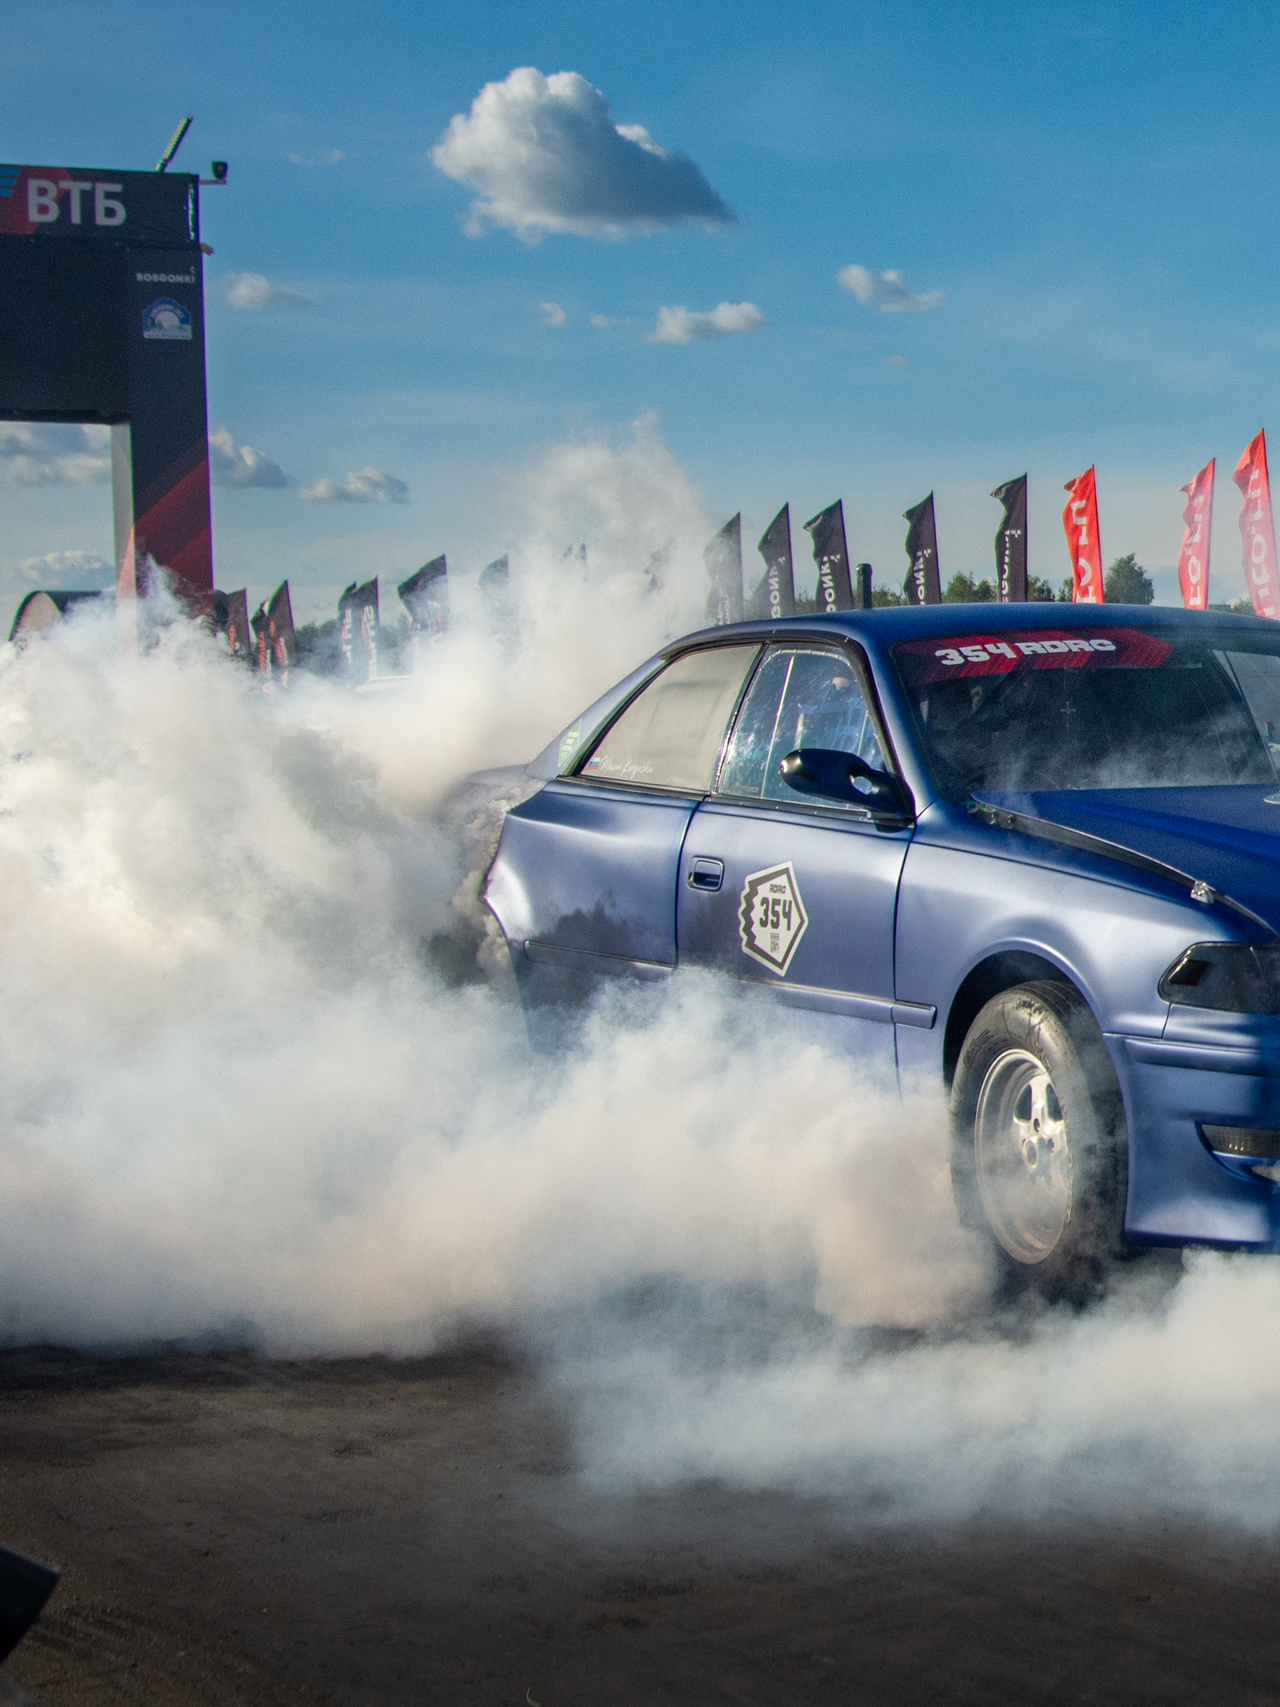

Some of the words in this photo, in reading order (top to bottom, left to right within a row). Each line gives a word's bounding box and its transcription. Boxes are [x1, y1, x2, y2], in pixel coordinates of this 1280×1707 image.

[27, 178, 127, 227] ВТБ
[136, 272, 195, 284] ROSGONKI
[934, 643, 1017, 666] 354
[1015, 639, 1117, 656] RDRC
[759, 896, 793, 932] 354
